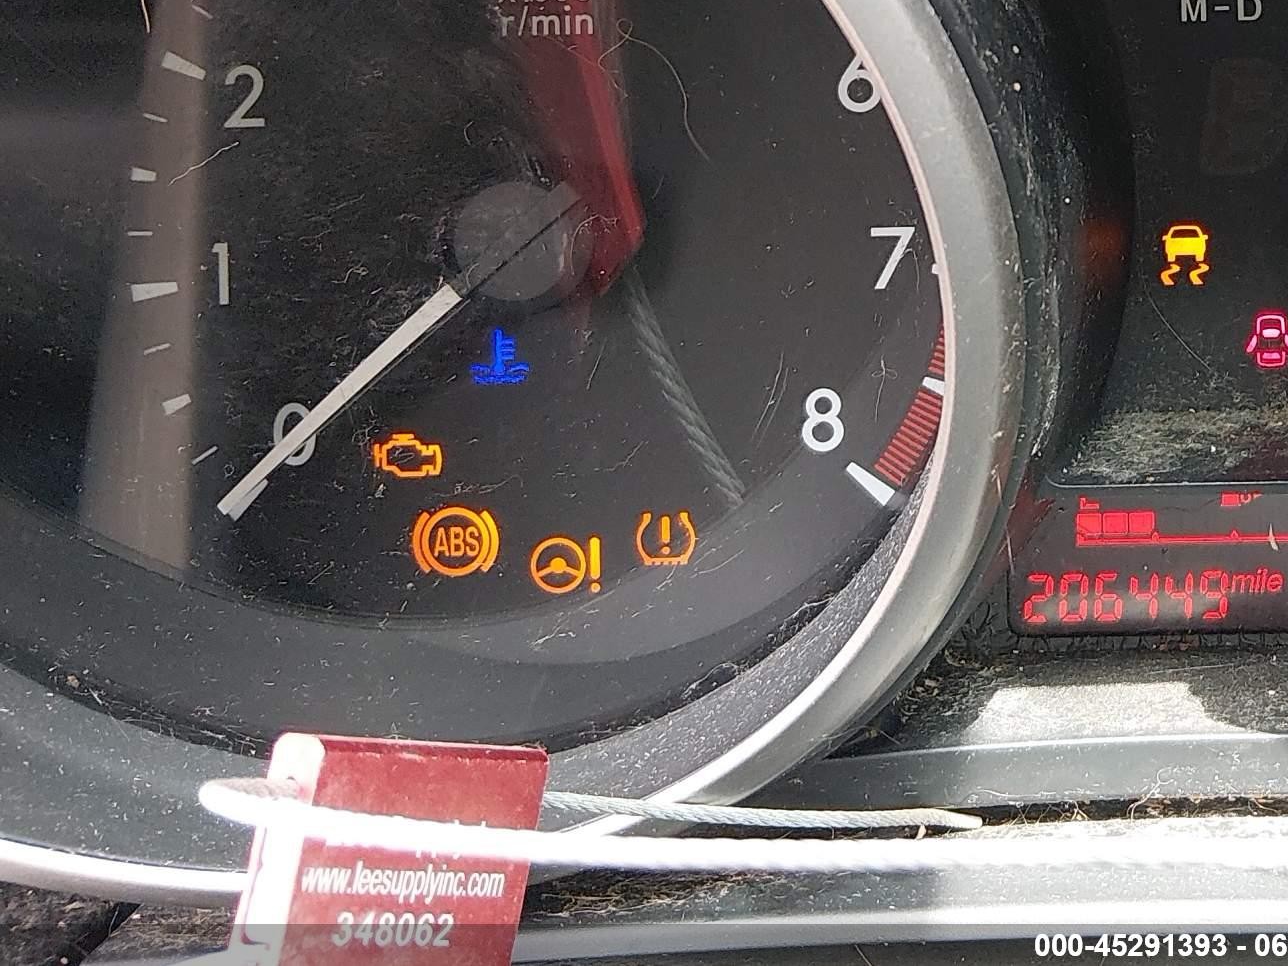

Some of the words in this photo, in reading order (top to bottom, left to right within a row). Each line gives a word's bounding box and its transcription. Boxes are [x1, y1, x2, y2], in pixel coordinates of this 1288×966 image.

[499, 7, 594, 36] r/min
[223, 64, 265, 128] 2
[838, 54, 881, 113] 6
[211, 243, 230, 306] 1
[870, 226, 916, 290] 7
[801, 388, 845, 453] 8
[433, 524, 482, 559] ABS
[1023, 570, 1230, 623] 206449
[1229, 568, 1283, 594] mile
[301, 860, 505, 904] www.leesupplyinc.com
[332, 912, 453, 947] 348062
